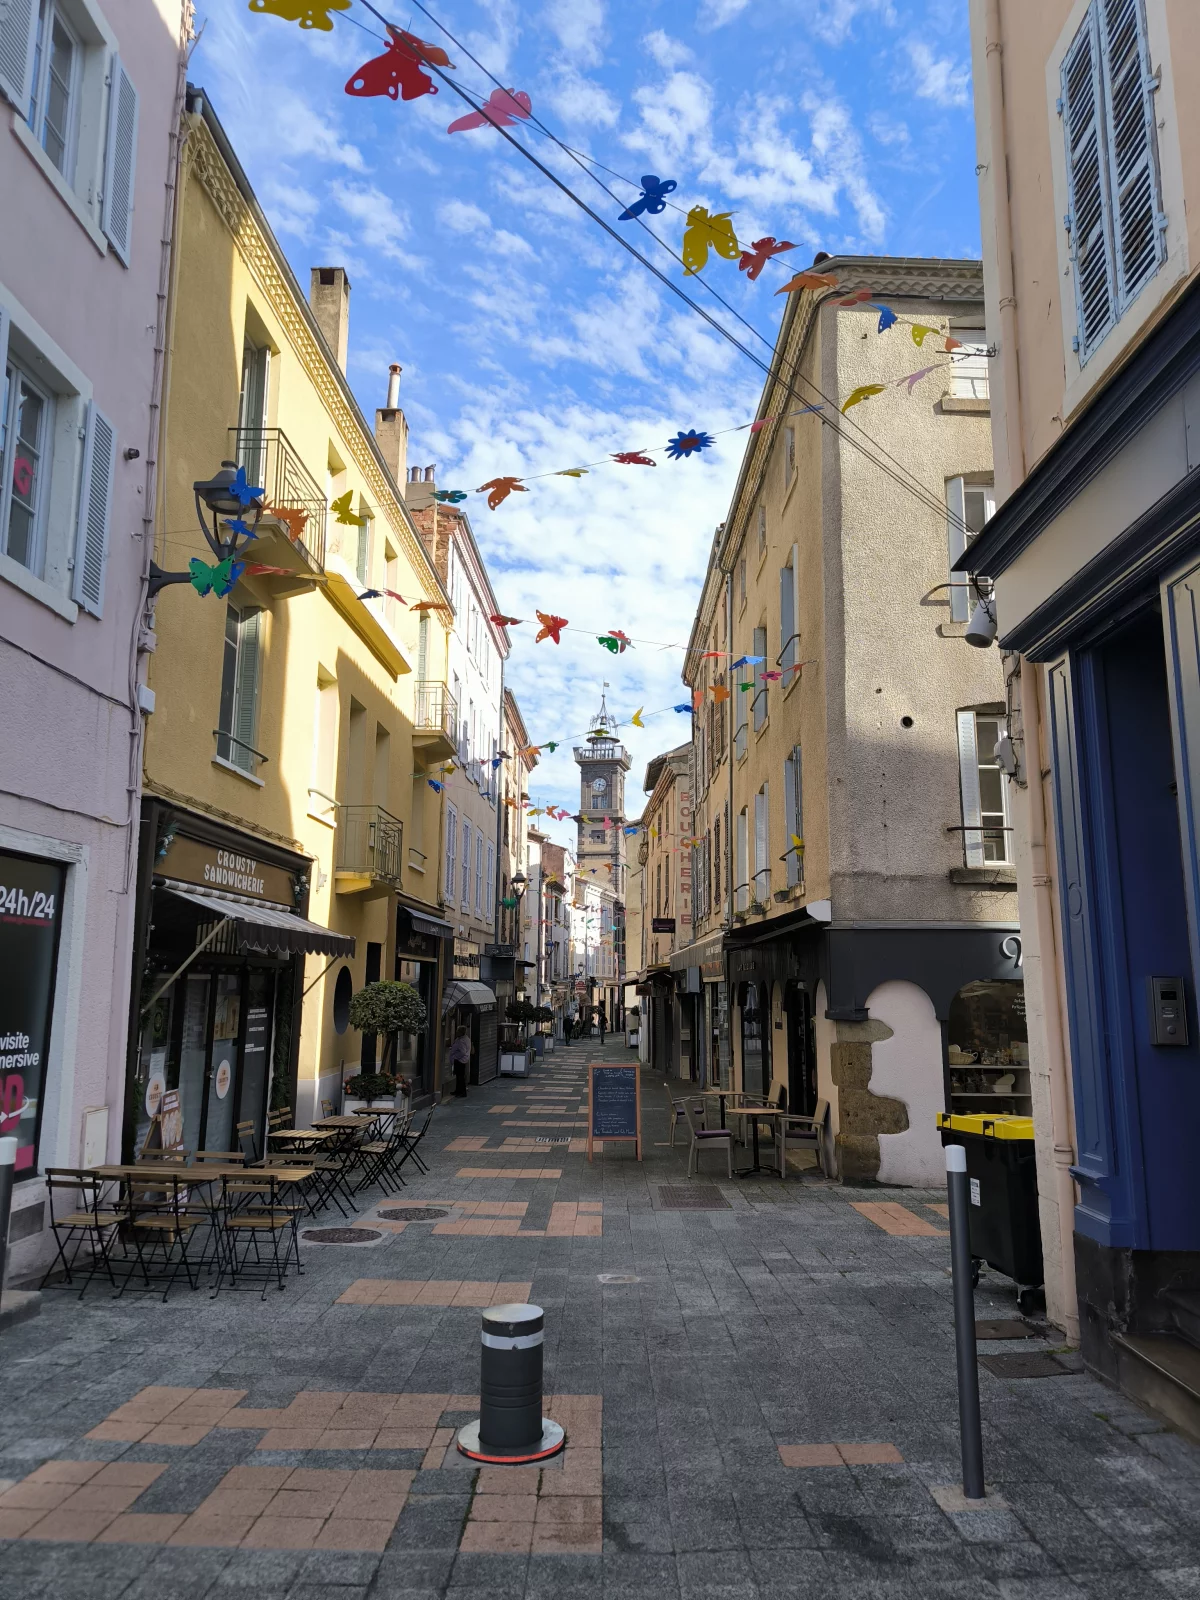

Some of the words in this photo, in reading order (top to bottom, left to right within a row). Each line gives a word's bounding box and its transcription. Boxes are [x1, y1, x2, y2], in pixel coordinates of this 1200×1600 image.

[217, 849, 257, 875] CROUSTY
[680, 792, 692, 925] BOUCHERIE
[204, 863, 265, 894] SANDWICHERIE
[0, 885, 55, 919] 24h/24
[0, 1031, 30, 1050] visite
